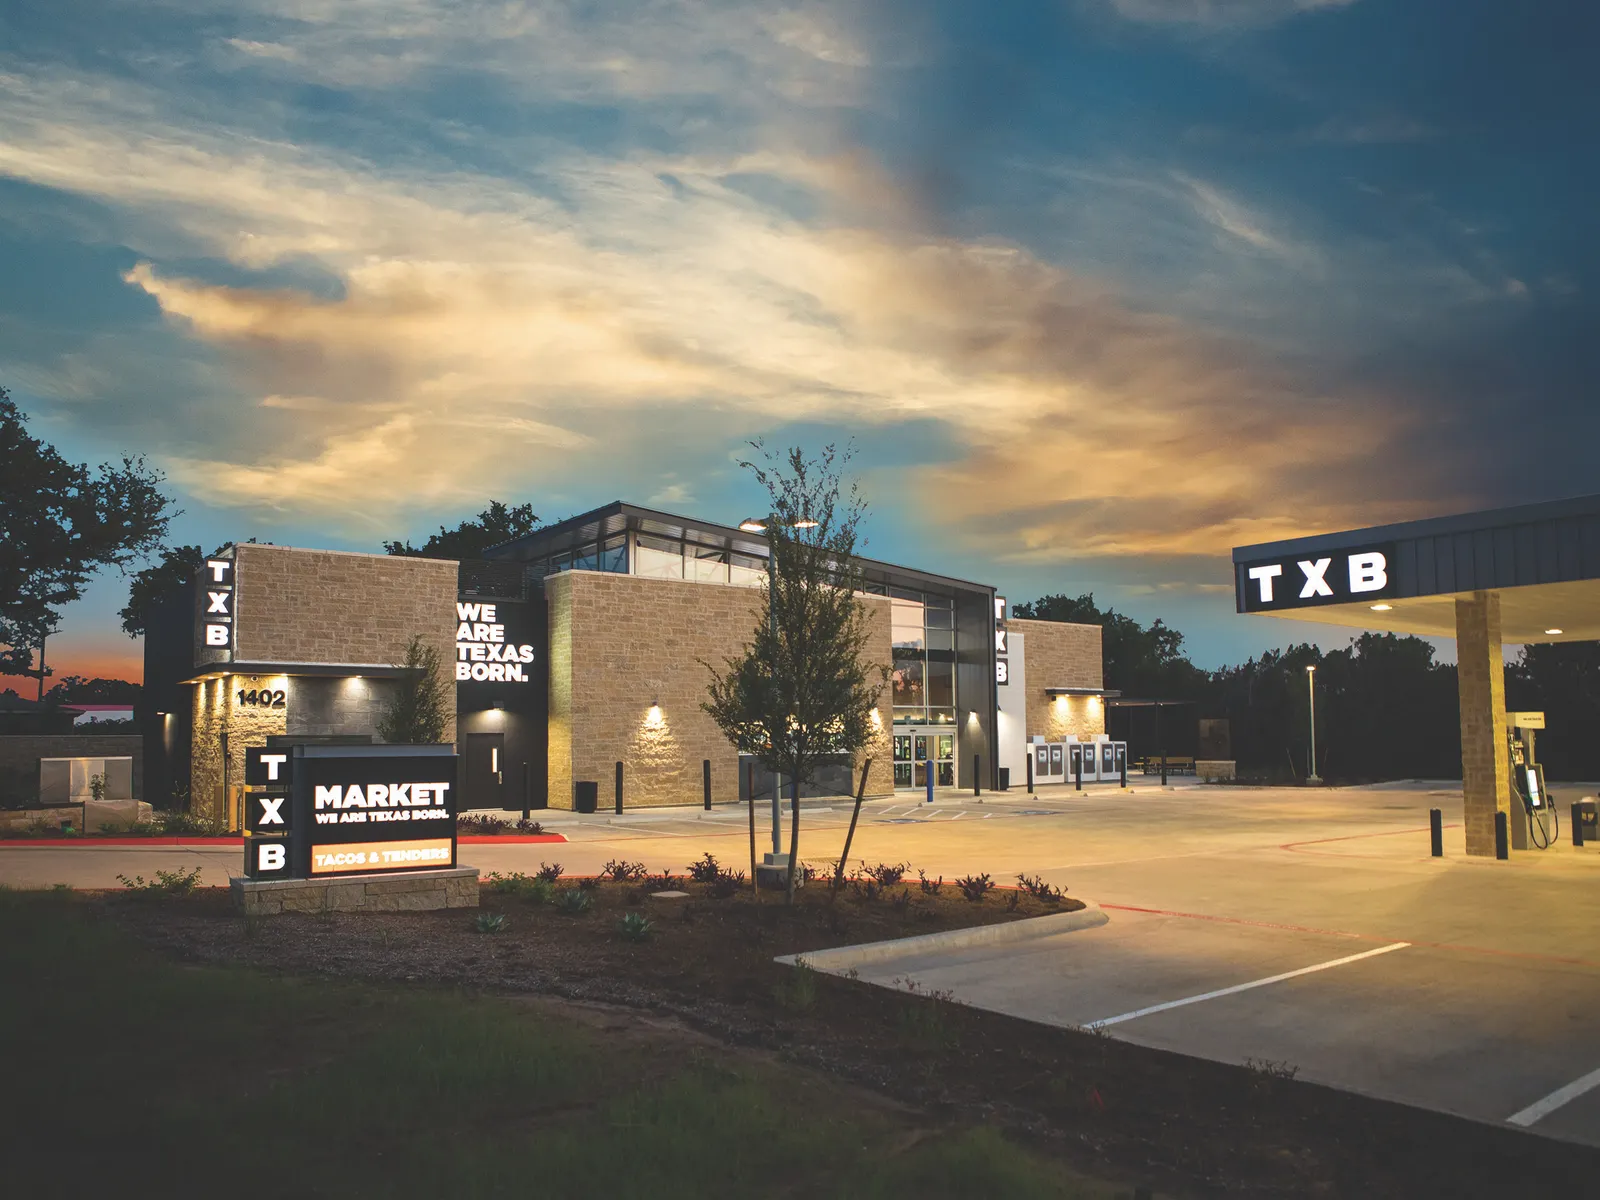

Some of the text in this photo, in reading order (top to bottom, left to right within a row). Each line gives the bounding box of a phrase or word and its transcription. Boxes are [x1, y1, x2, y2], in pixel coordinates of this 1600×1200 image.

[1248, 551, 1388, 603] TXB
[206, 560, 230, 646] TXB
[456, 602, 496, 622] WE
[456, 622, 505, 642] ARE
[456, 641, 535, 663] TEXAS
[456, 661, 529, 682] BORN.
[237, 689, 286, 708] 1402
[314, 782, 450, 810] MARKET
[258, 753, 287, 871] TXB
[315, 809, 450, 824] WE ARE TEXAS BORN.
[315, 847, 450, 867] TACOS & TENDERS
